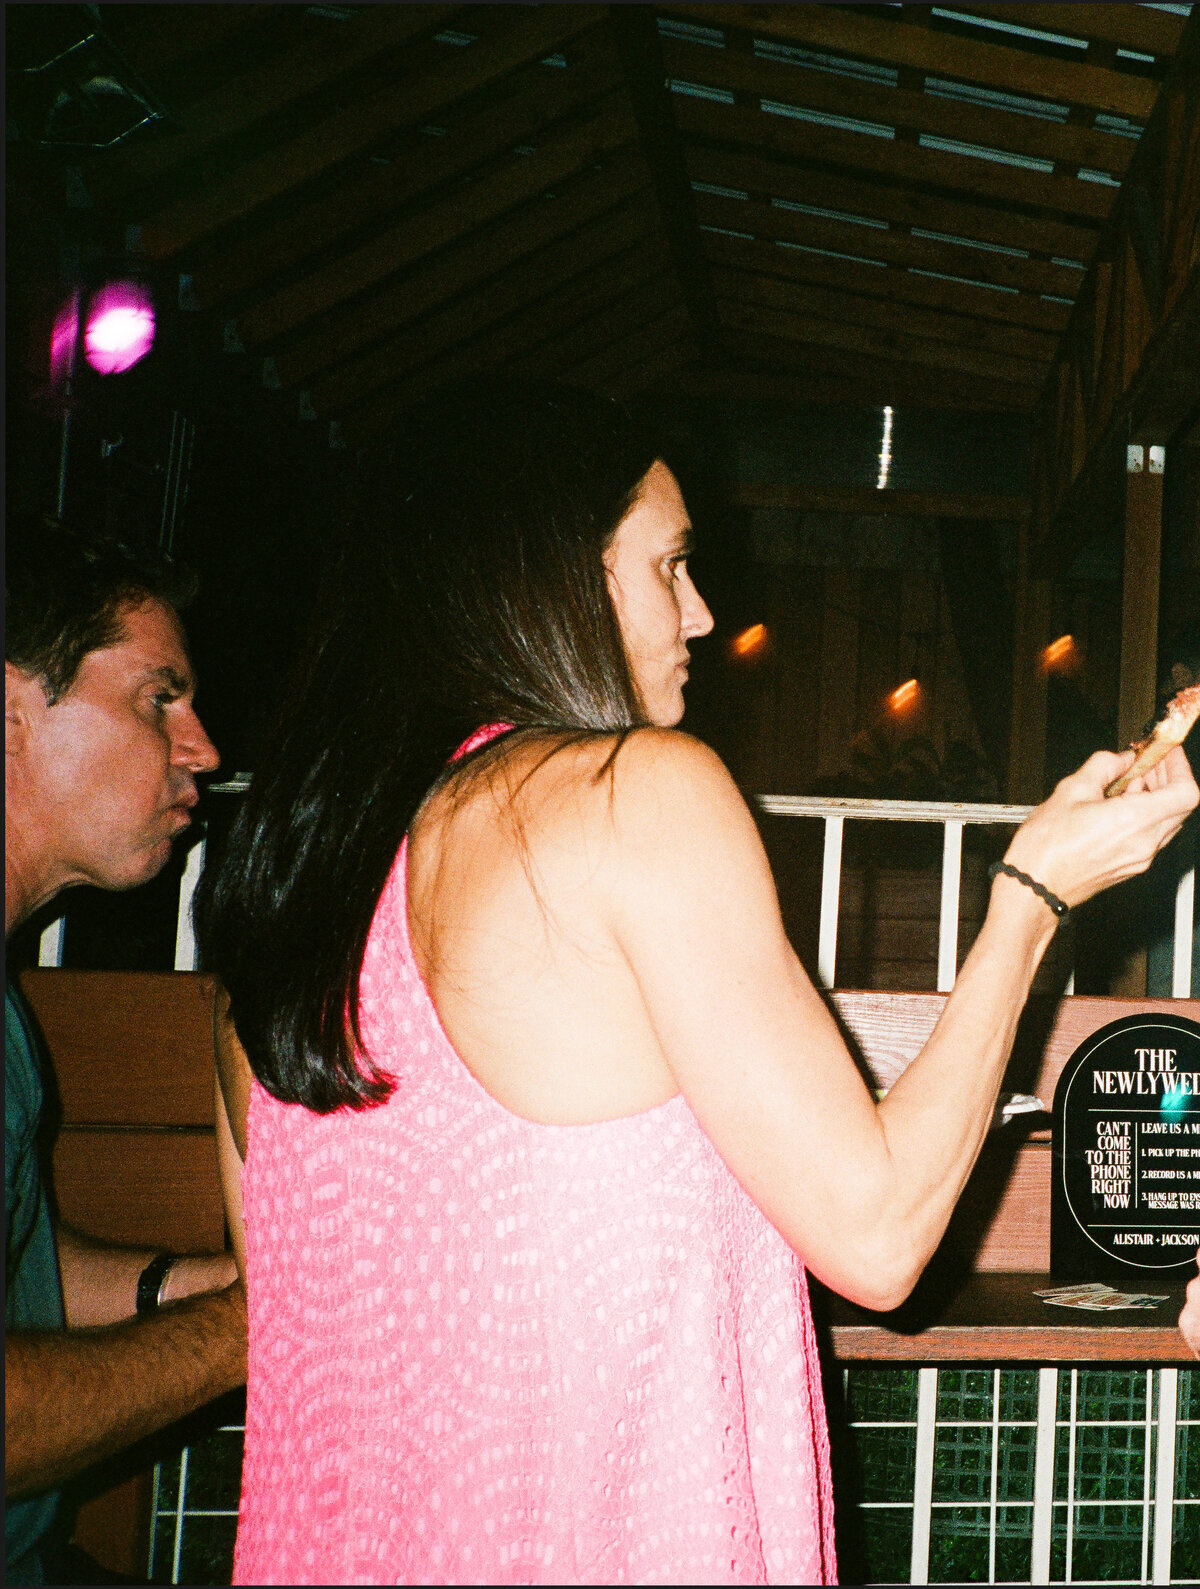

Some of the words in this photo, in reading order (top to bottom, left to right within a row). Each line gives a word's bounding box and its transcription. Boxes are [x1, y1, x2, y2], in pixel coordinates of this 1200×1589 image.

[1134, 1048, 1177, 1072] THE
[1096, 1121, 1131, 1136] CAN'T
[1141, 1122, 1168, 1134] LEAVE
[1169, 1123, 1181, 1134] US
[1183, 1124, 1190, 1135] A
[1097, 1135, 1131, 1151] COME
[1084, 1149, 1104, 1165] TO
[1105, 1150, 1131, 1165] THE
[1147, 1148, 1164, 1157] PICK
[1164, 1148, 1175, 1157] UP
[1175, 1148, 1190, 1158] THE
[1090, 1164, 1132, 1180] PHONE
[1176, 1170, 1186, 1179] US
[1186, 1171, 1192, 1180] A
[1091, 1179, 1132, 1194] RIGHT
[1103, 1194, 1131, 1209] NOW
[1167, 1193, 1178, 1201] UP
[1178, 1192, 1190, 1202] TO
[1148, 1200, 1179, 1210] MESSAGE
[1179, 1201, 1195, 1210] WAS
[1112, 1233, 1154, 1246] ALISTAIR
[1161, 1233, 1200, 1247] JACKSON
